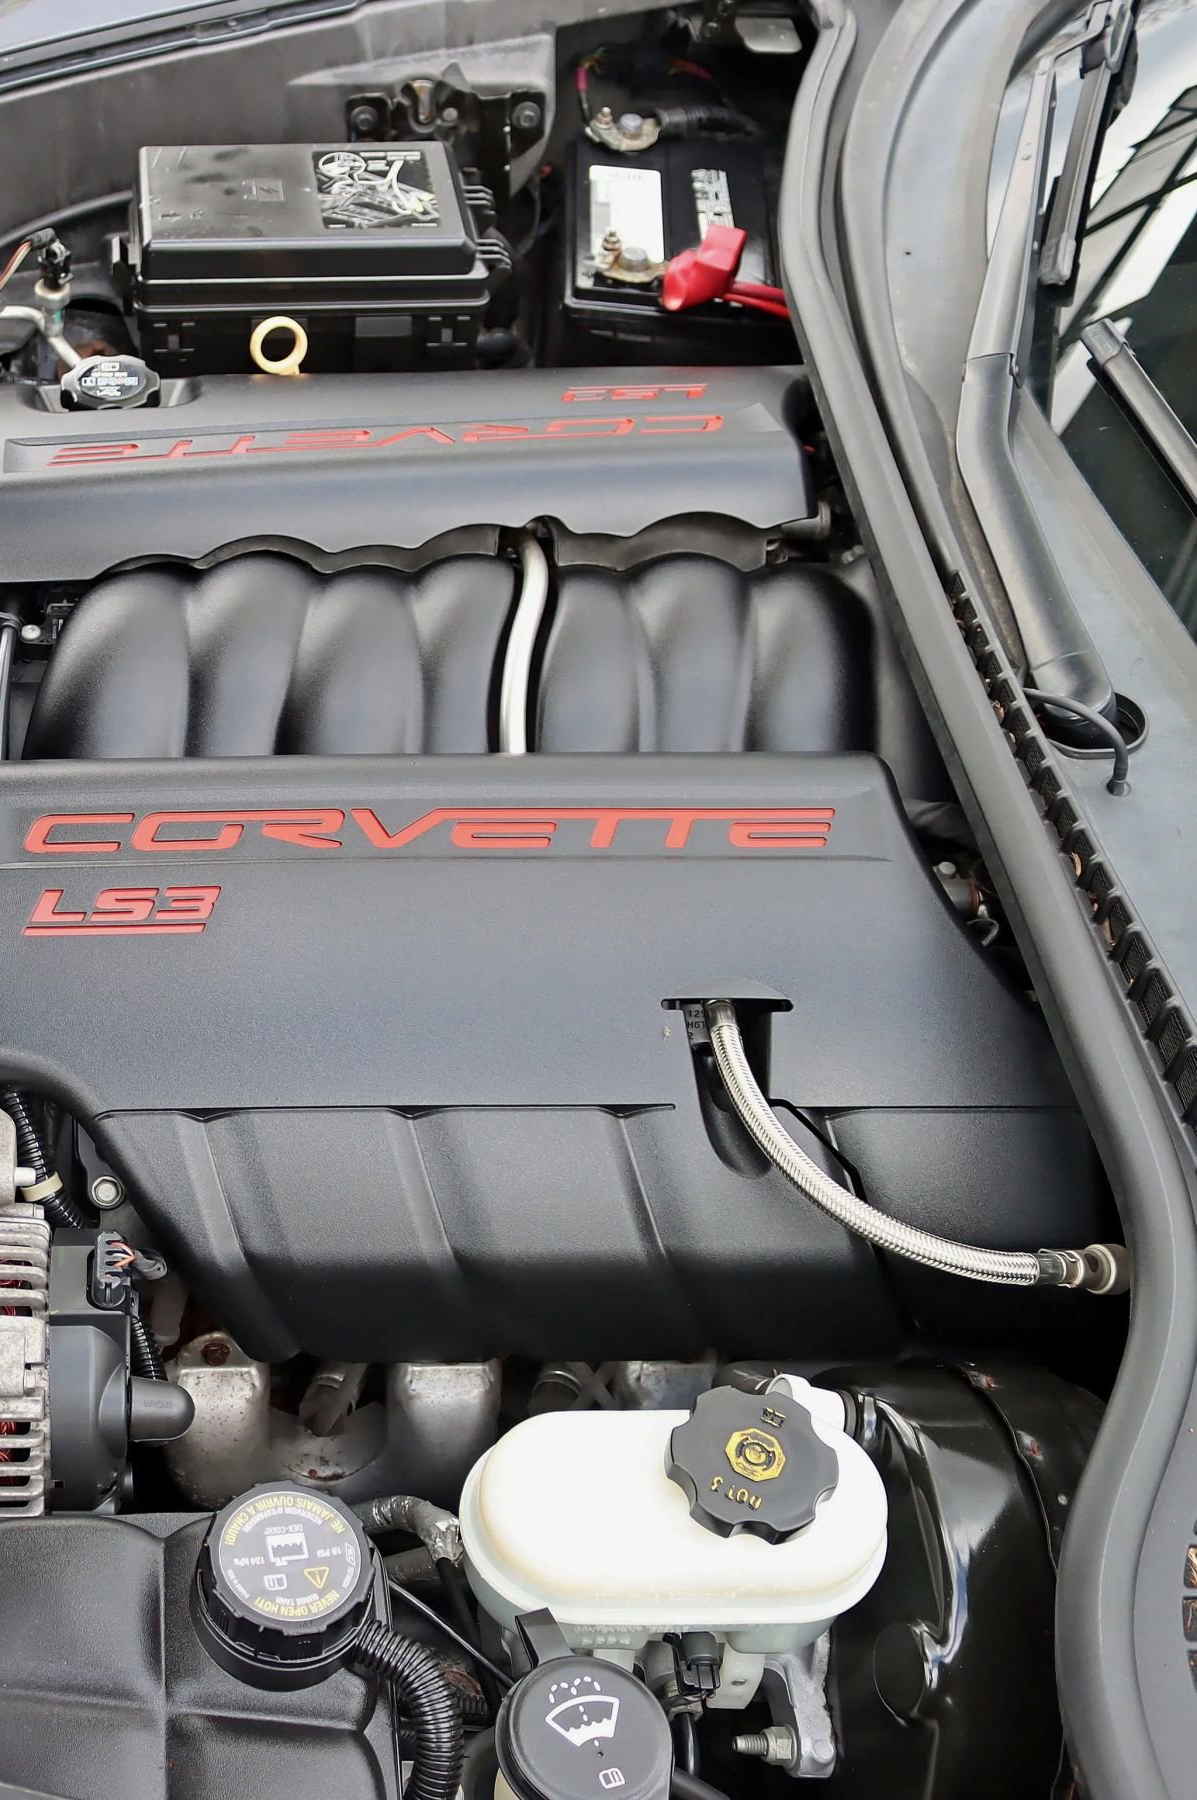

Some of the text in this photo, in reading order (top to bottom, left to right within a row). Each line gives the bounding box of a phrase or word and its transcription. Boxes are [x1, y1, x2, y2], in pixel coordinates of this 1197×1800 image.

[562, 385, 707, 403] LS3
[47, 415, 724, 466] CORVETTE
[24, 808, 836, 854] CORVETTE
[25, 885, 222, 930] LS3
[257, 1496, 294, 1512] OUVRIR
[710, 1476, 762, 1510] DOT 3
[296, 1497, 335, 1521] JAMAIS
[225, 1514, 250, 1546] CHAUD!
[331, 1519, 347, 1535] NE
[233, 1556, 265, 1567] 124 kPa
[316, 1548, 331, 1558] PSI
[254, 1590, 341, 1617] NEVER OPEN HOT!
[275, 1596, 295, 1606] TANK
